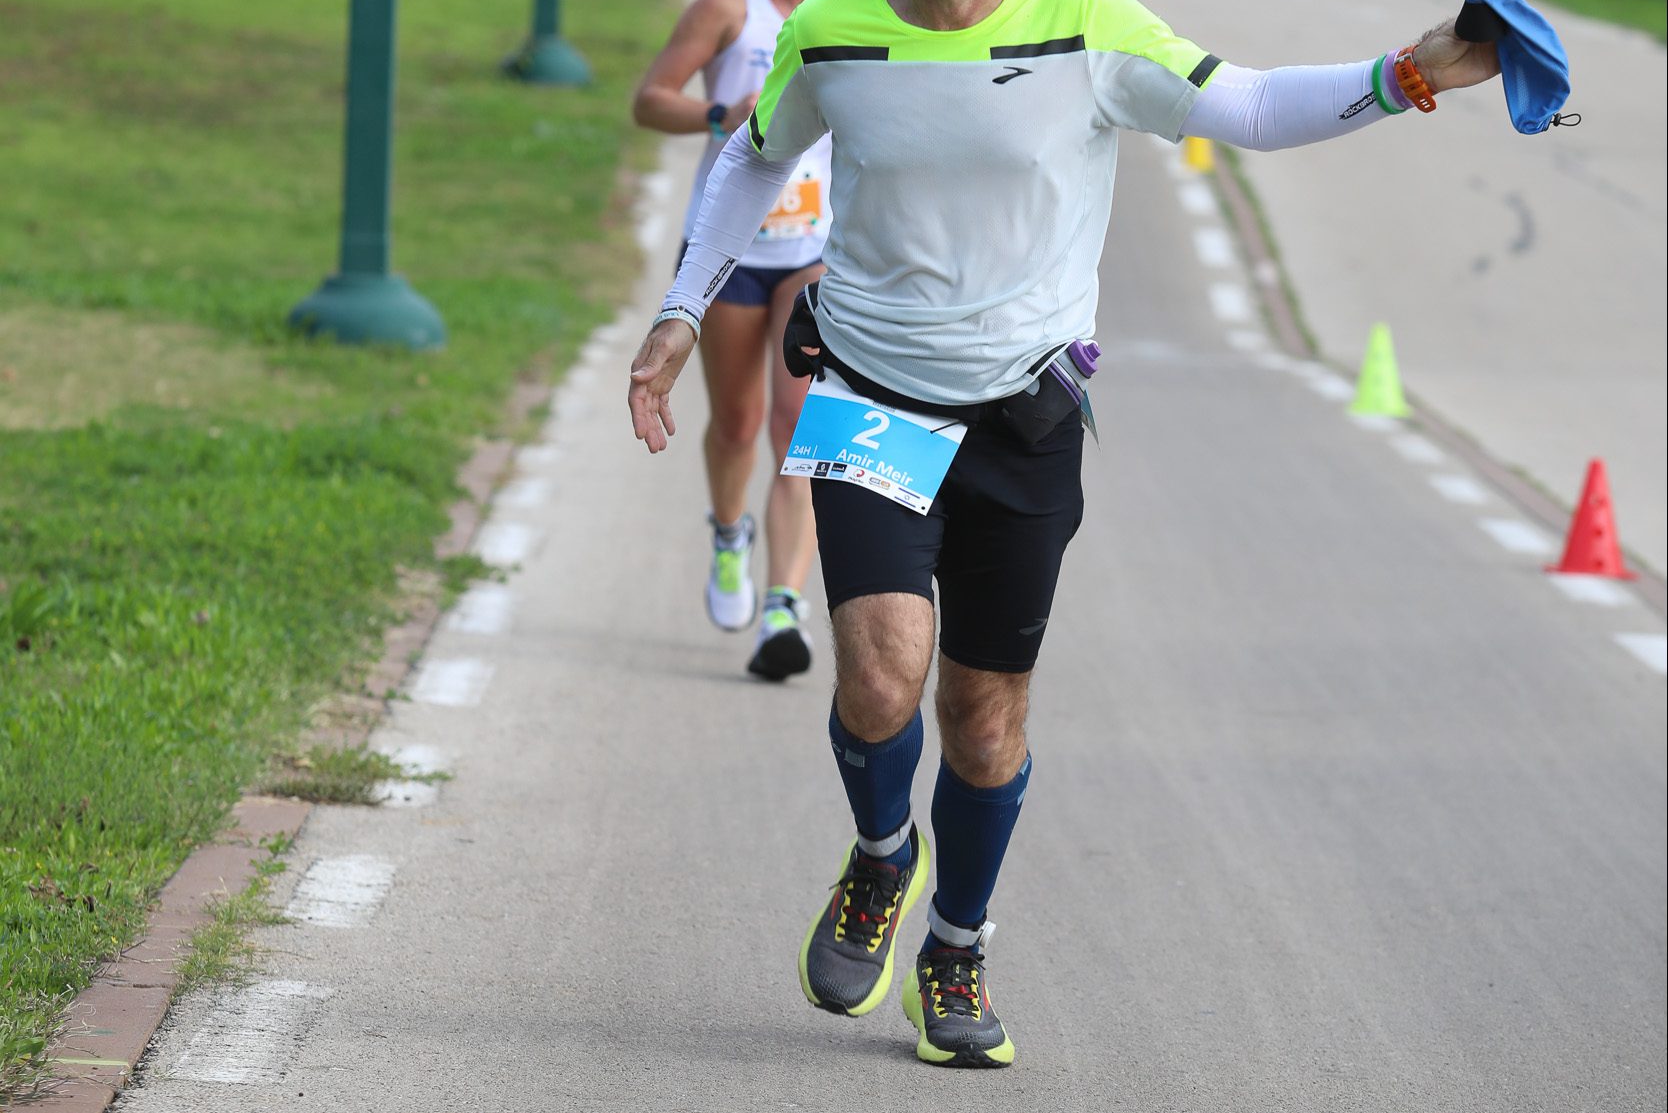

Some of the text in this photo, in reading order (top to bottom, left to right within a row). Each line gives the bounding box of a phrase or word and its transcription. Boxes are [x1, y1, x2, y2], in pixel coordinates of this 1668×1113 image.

[852, 410, 890, 450] 2
[792, 445, 811, 456] 24H
[836, 448, 875, 469] Amir
[875, 460, 914, 486] Meir
